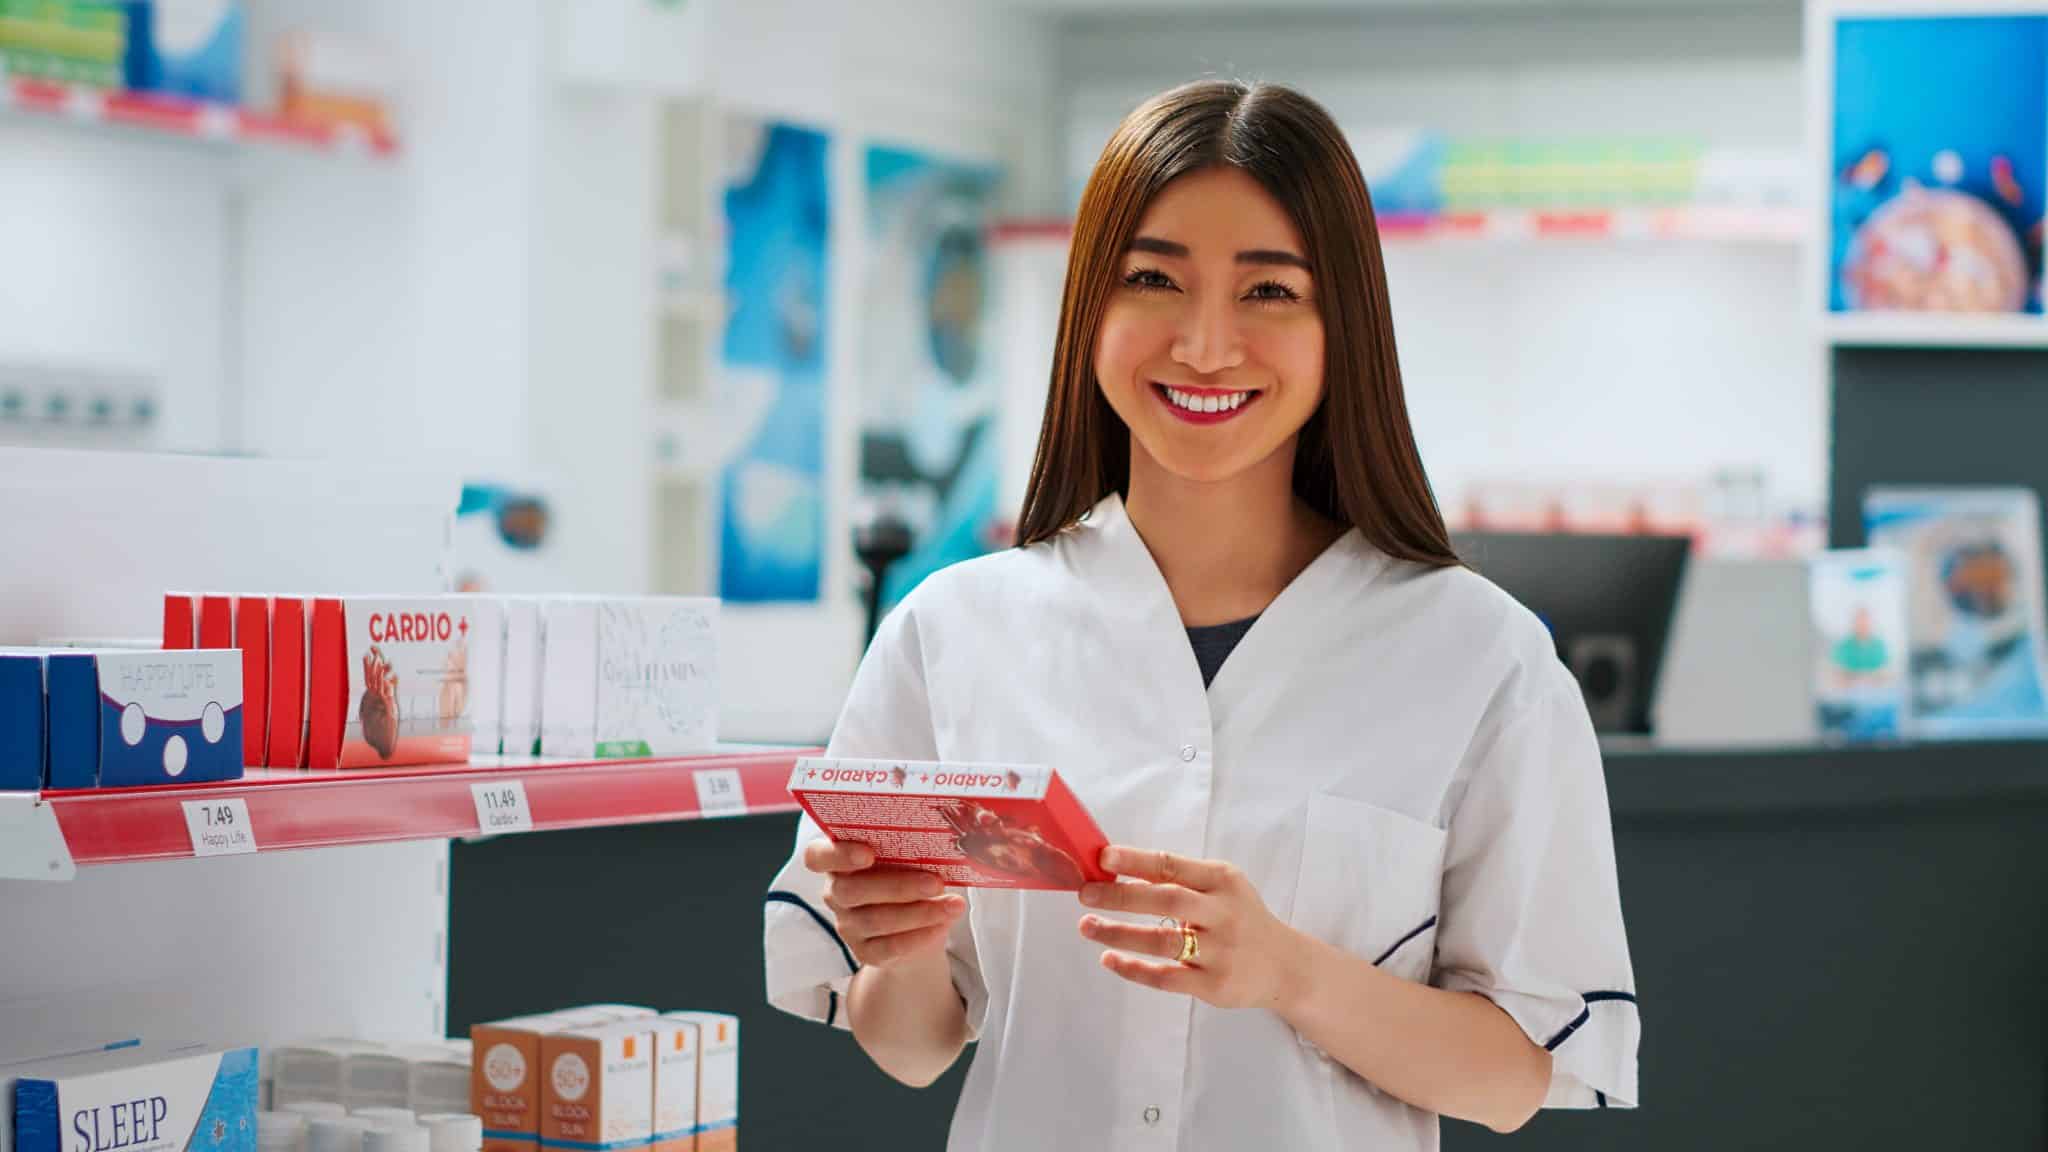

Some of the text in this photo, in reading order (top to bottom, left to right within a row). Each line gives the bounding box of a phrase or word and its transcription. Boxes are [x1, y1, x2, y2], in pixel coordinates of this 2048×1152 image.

[369, 613, 452, 642] CARDIO
[120, 664, 215, 691] HAPPY LIFE
[822, 768, 889, 783] CARDIO
[935, 773, 1002, 787] CARDIO
[484, 789, 516, 809] 11.49
[201, 806, 233, 826] 7.49
[202, 829, 246, 848] Happy Life
[74, 1096, 168, 1152] SLEEP
